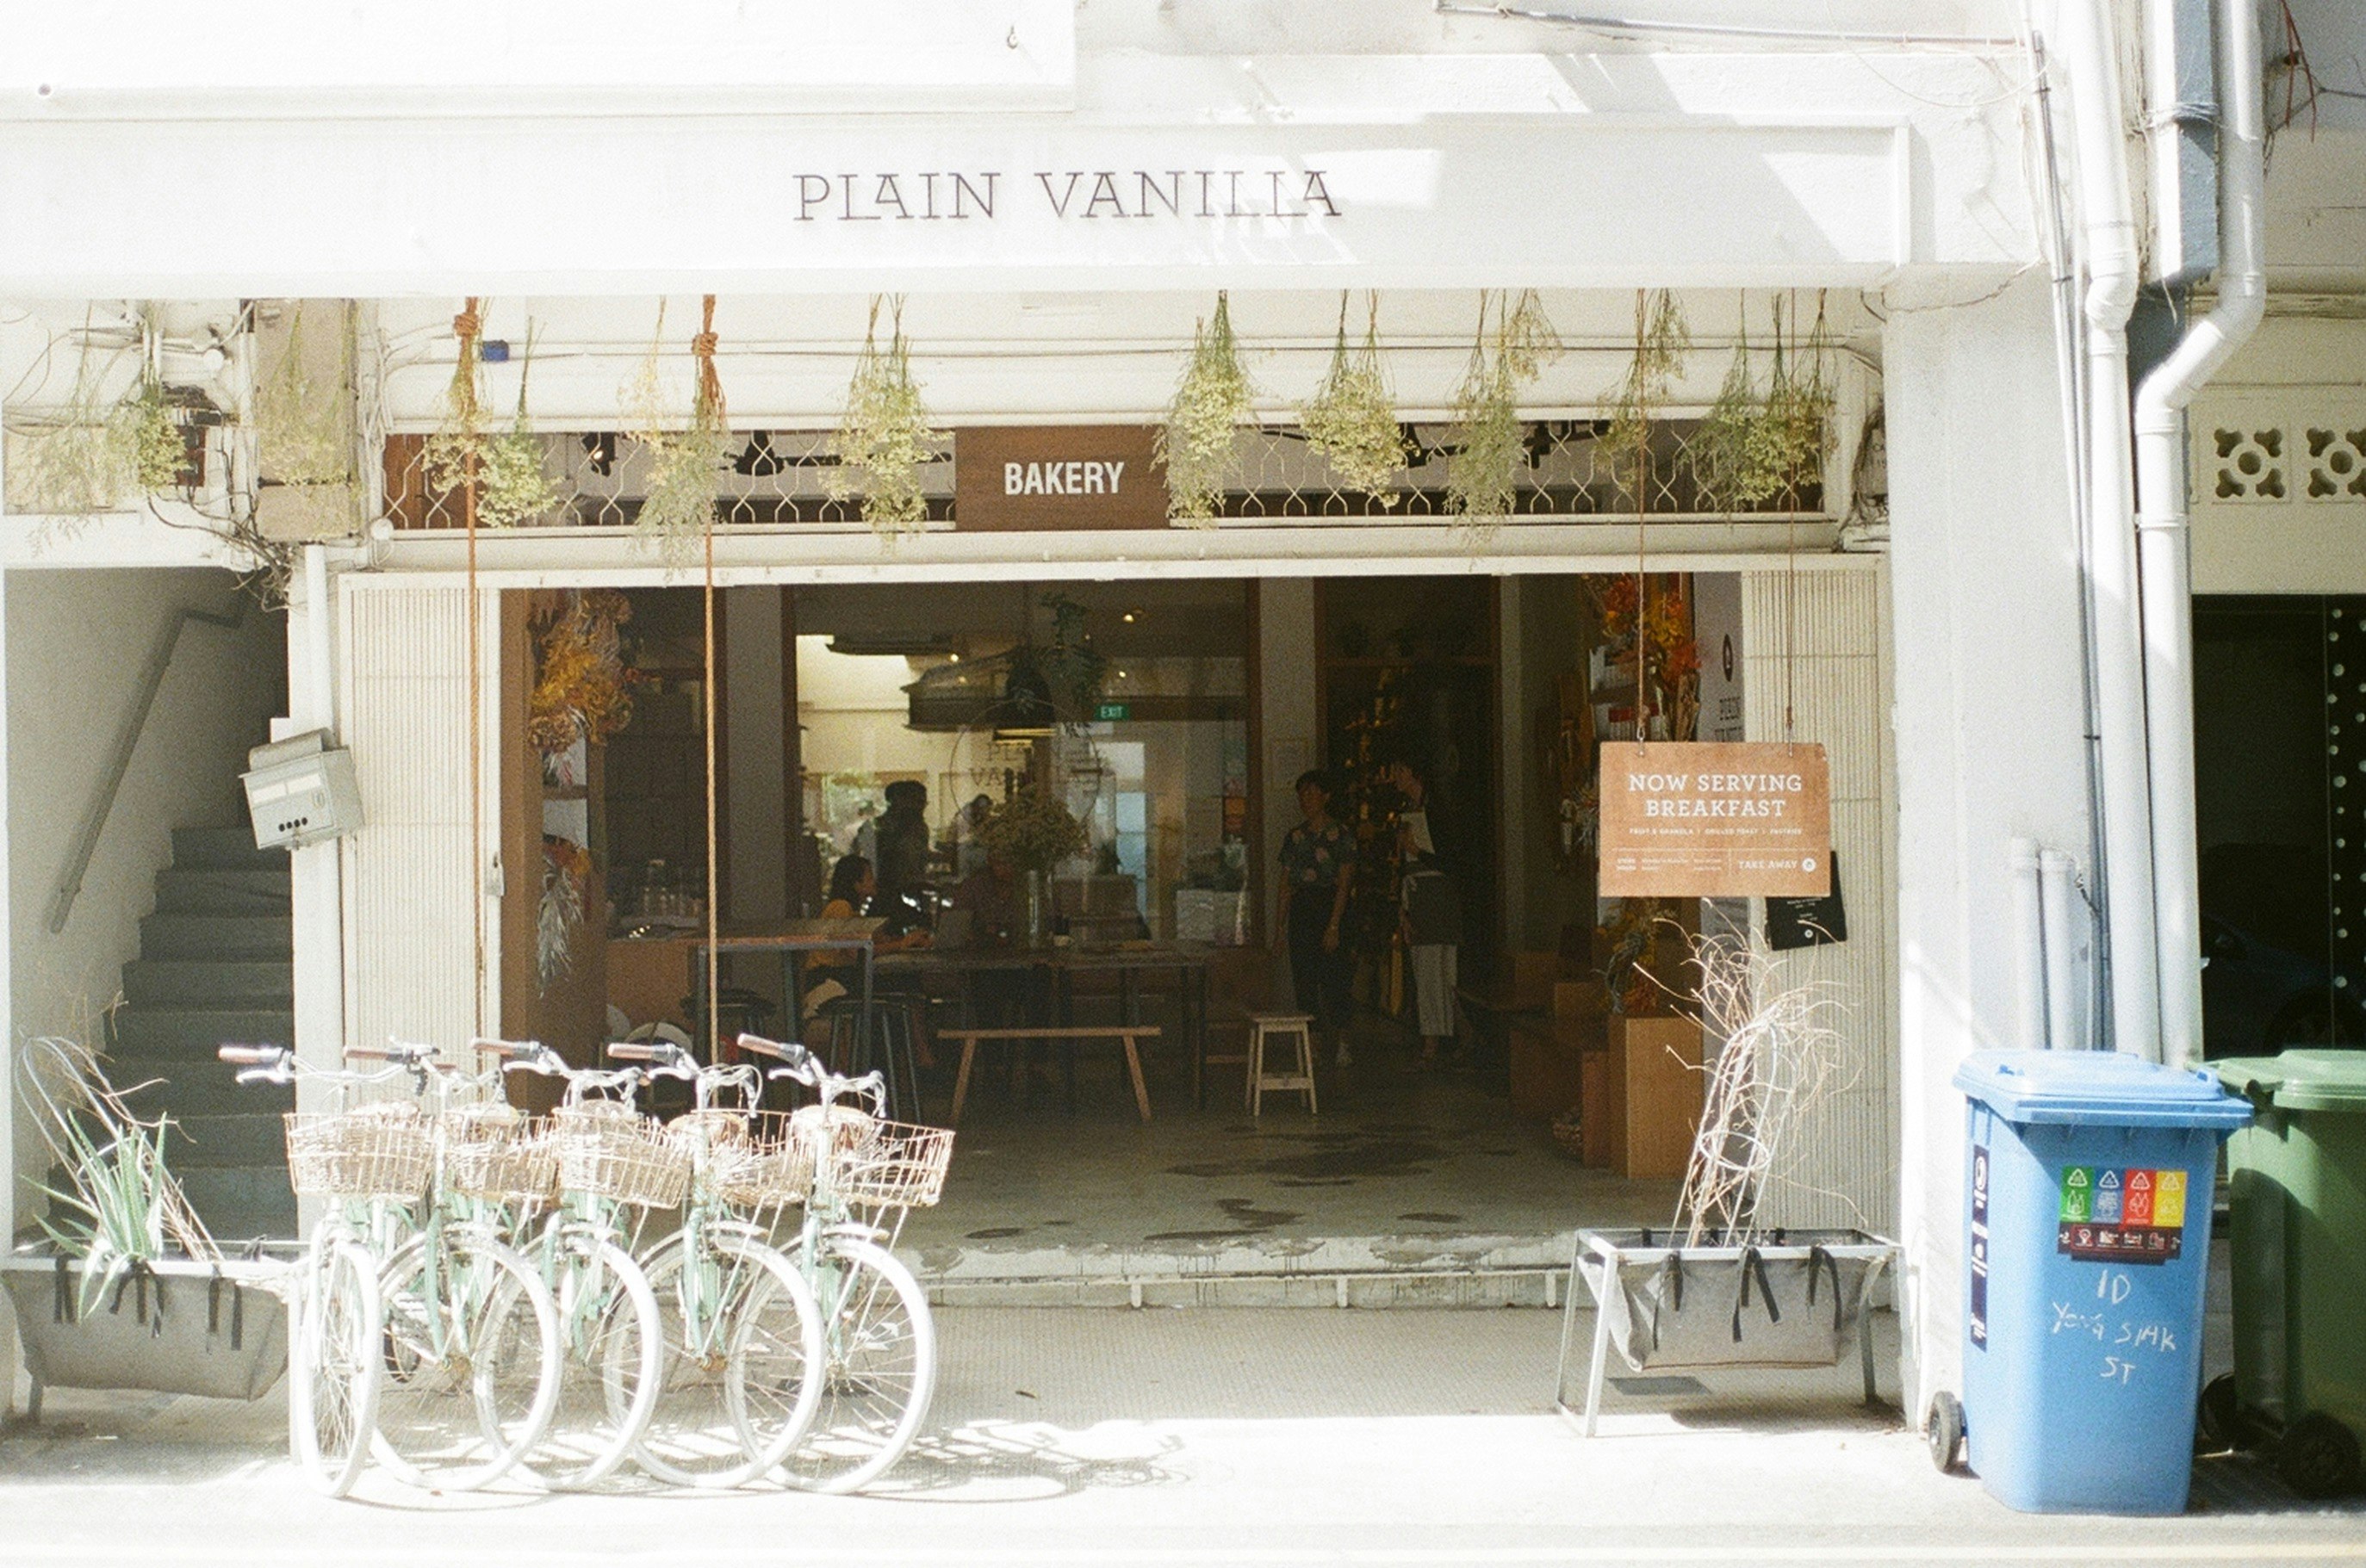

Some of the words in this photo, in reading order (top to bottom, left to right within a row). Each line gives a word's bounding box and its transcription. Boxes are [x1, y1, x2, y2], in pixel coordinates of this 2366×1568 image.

[792, 171, 1001, 220] PLAIN
[1034, 170, 1342, 219] VANILLA
[1004, 461, 1125, 495] BAKERY
[1101, 705, 1123, 720] EXIT
[1629, 773, 1688, 792] NOW
[1698, 773, 1802, 792] SERVING
[1645, 799, 1786, 817] BREAKFAST
[1738, 859, 1764, 870] TAKE
[1768, 859, 1798, 870] AWAY
